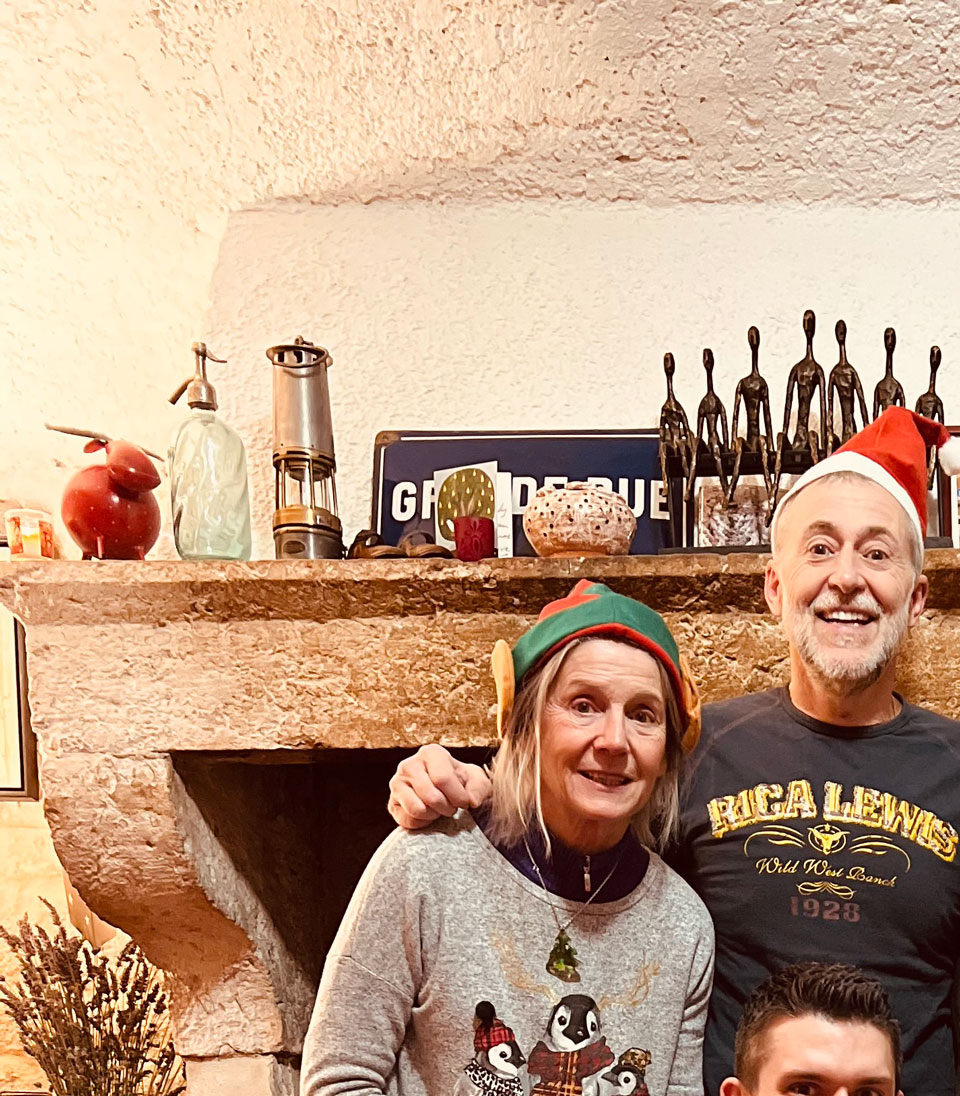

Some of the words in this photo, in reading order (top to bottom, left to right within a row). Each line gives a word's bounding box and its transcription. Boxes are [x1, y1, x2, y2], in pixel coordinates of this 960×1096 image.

[707, 779, 817, 839] RICA
[823, 780, 959, 863] LEWIS
[755, 856, 800, 875] Wild
[803, 858, 844, 878] West
[846, 866, 898, 888] Ranch
[790, 896, 861, 923] 1928
